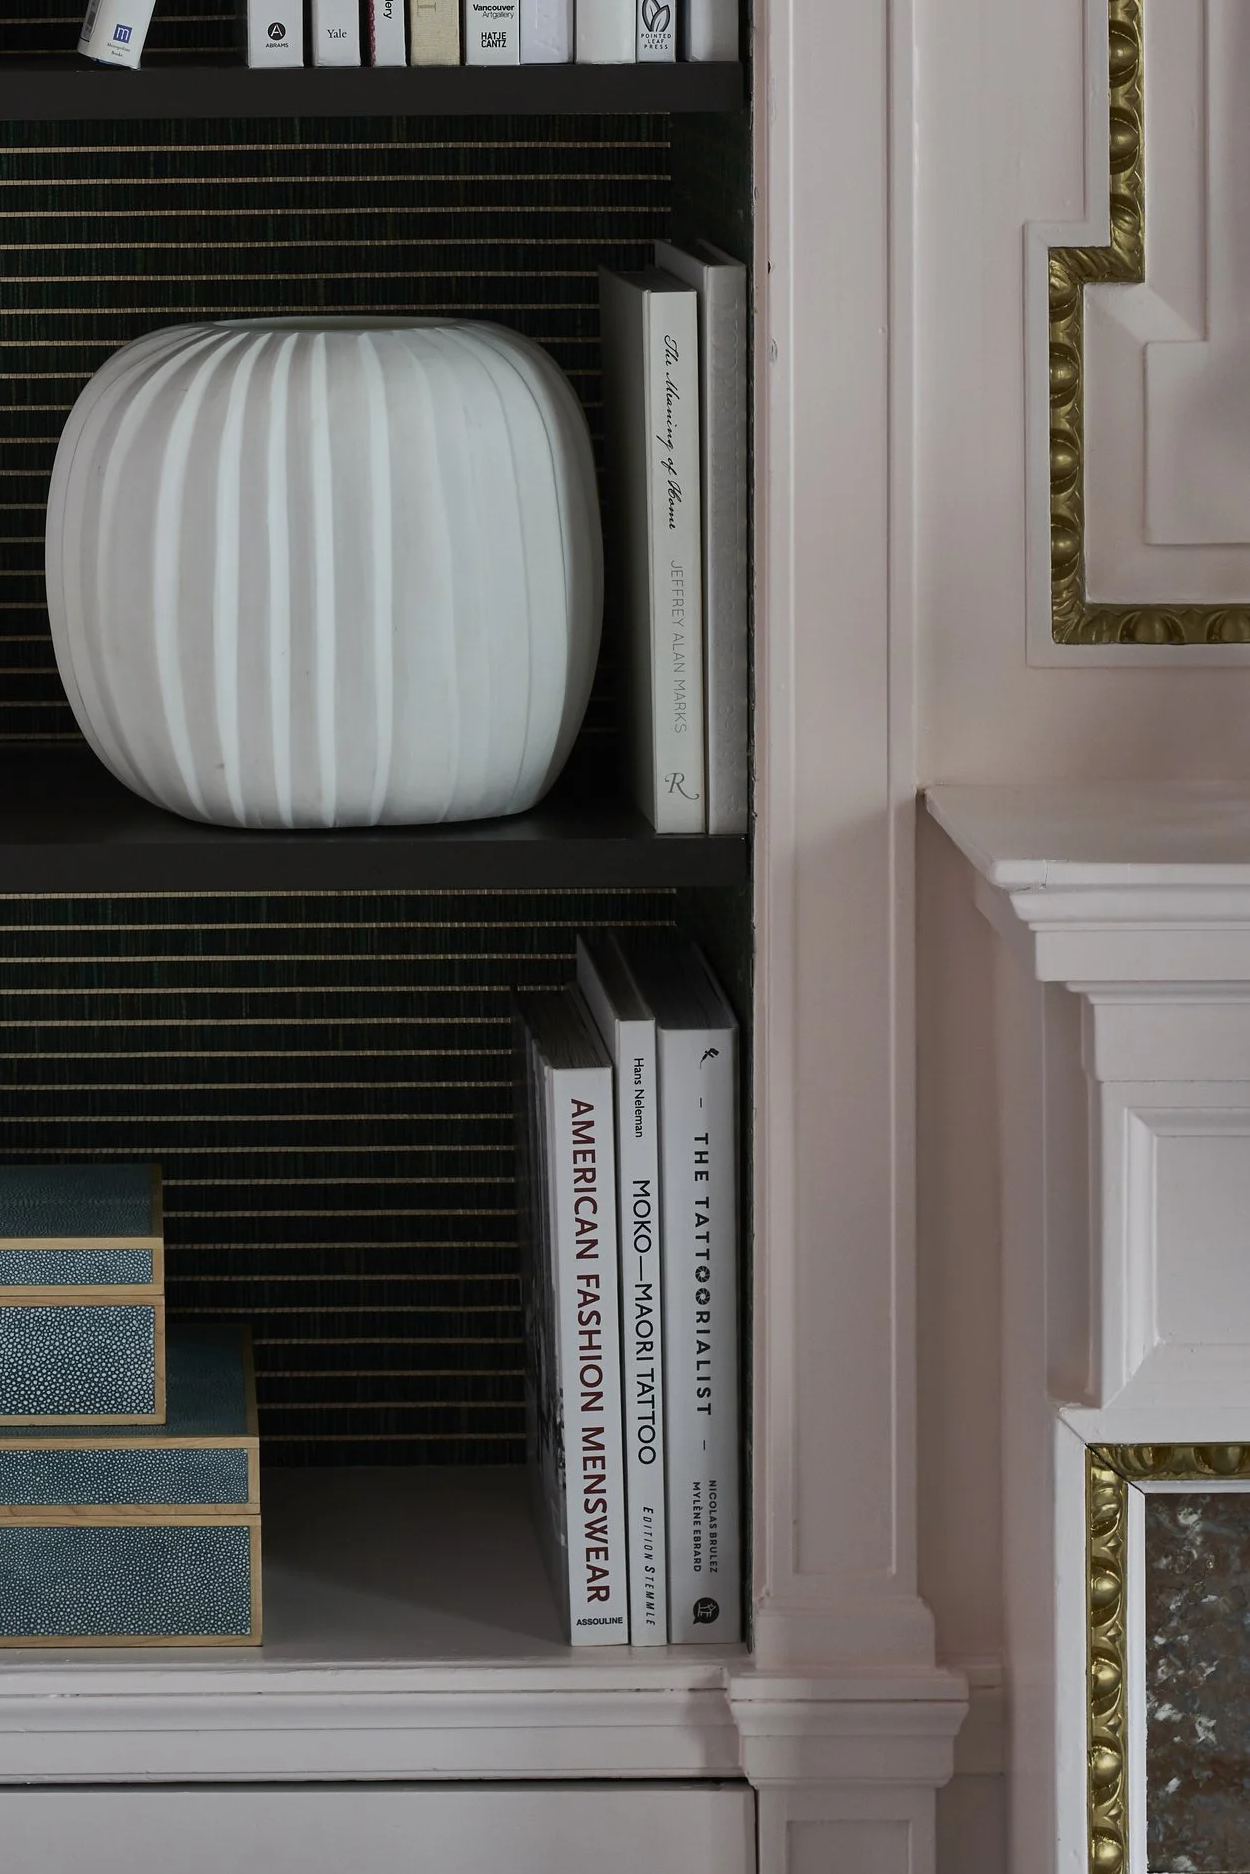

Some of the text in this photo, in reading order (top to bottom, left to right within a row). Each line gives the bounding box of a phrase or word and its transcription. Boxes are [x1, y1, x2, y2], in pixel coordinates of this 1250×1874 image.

[327, 29, 347, 39] Yale
[481, 32, 506, 40] HATJE
[481, 40, 507, 48] CANTZ
[670, 559, 687, 734] JEFFREY ALAN MARKS
[633, 1057, 644, 1138] Hans Neleman
[571, 1099, 610, 1603] AMERICAN FASHION MENSWEAR
[635, 1368, 656, 1465] TATTOO
[692, 1482, 702, 1572] MYLÈNE EBRARD
[576, 1617, 623, 1626] ASSOULINE
